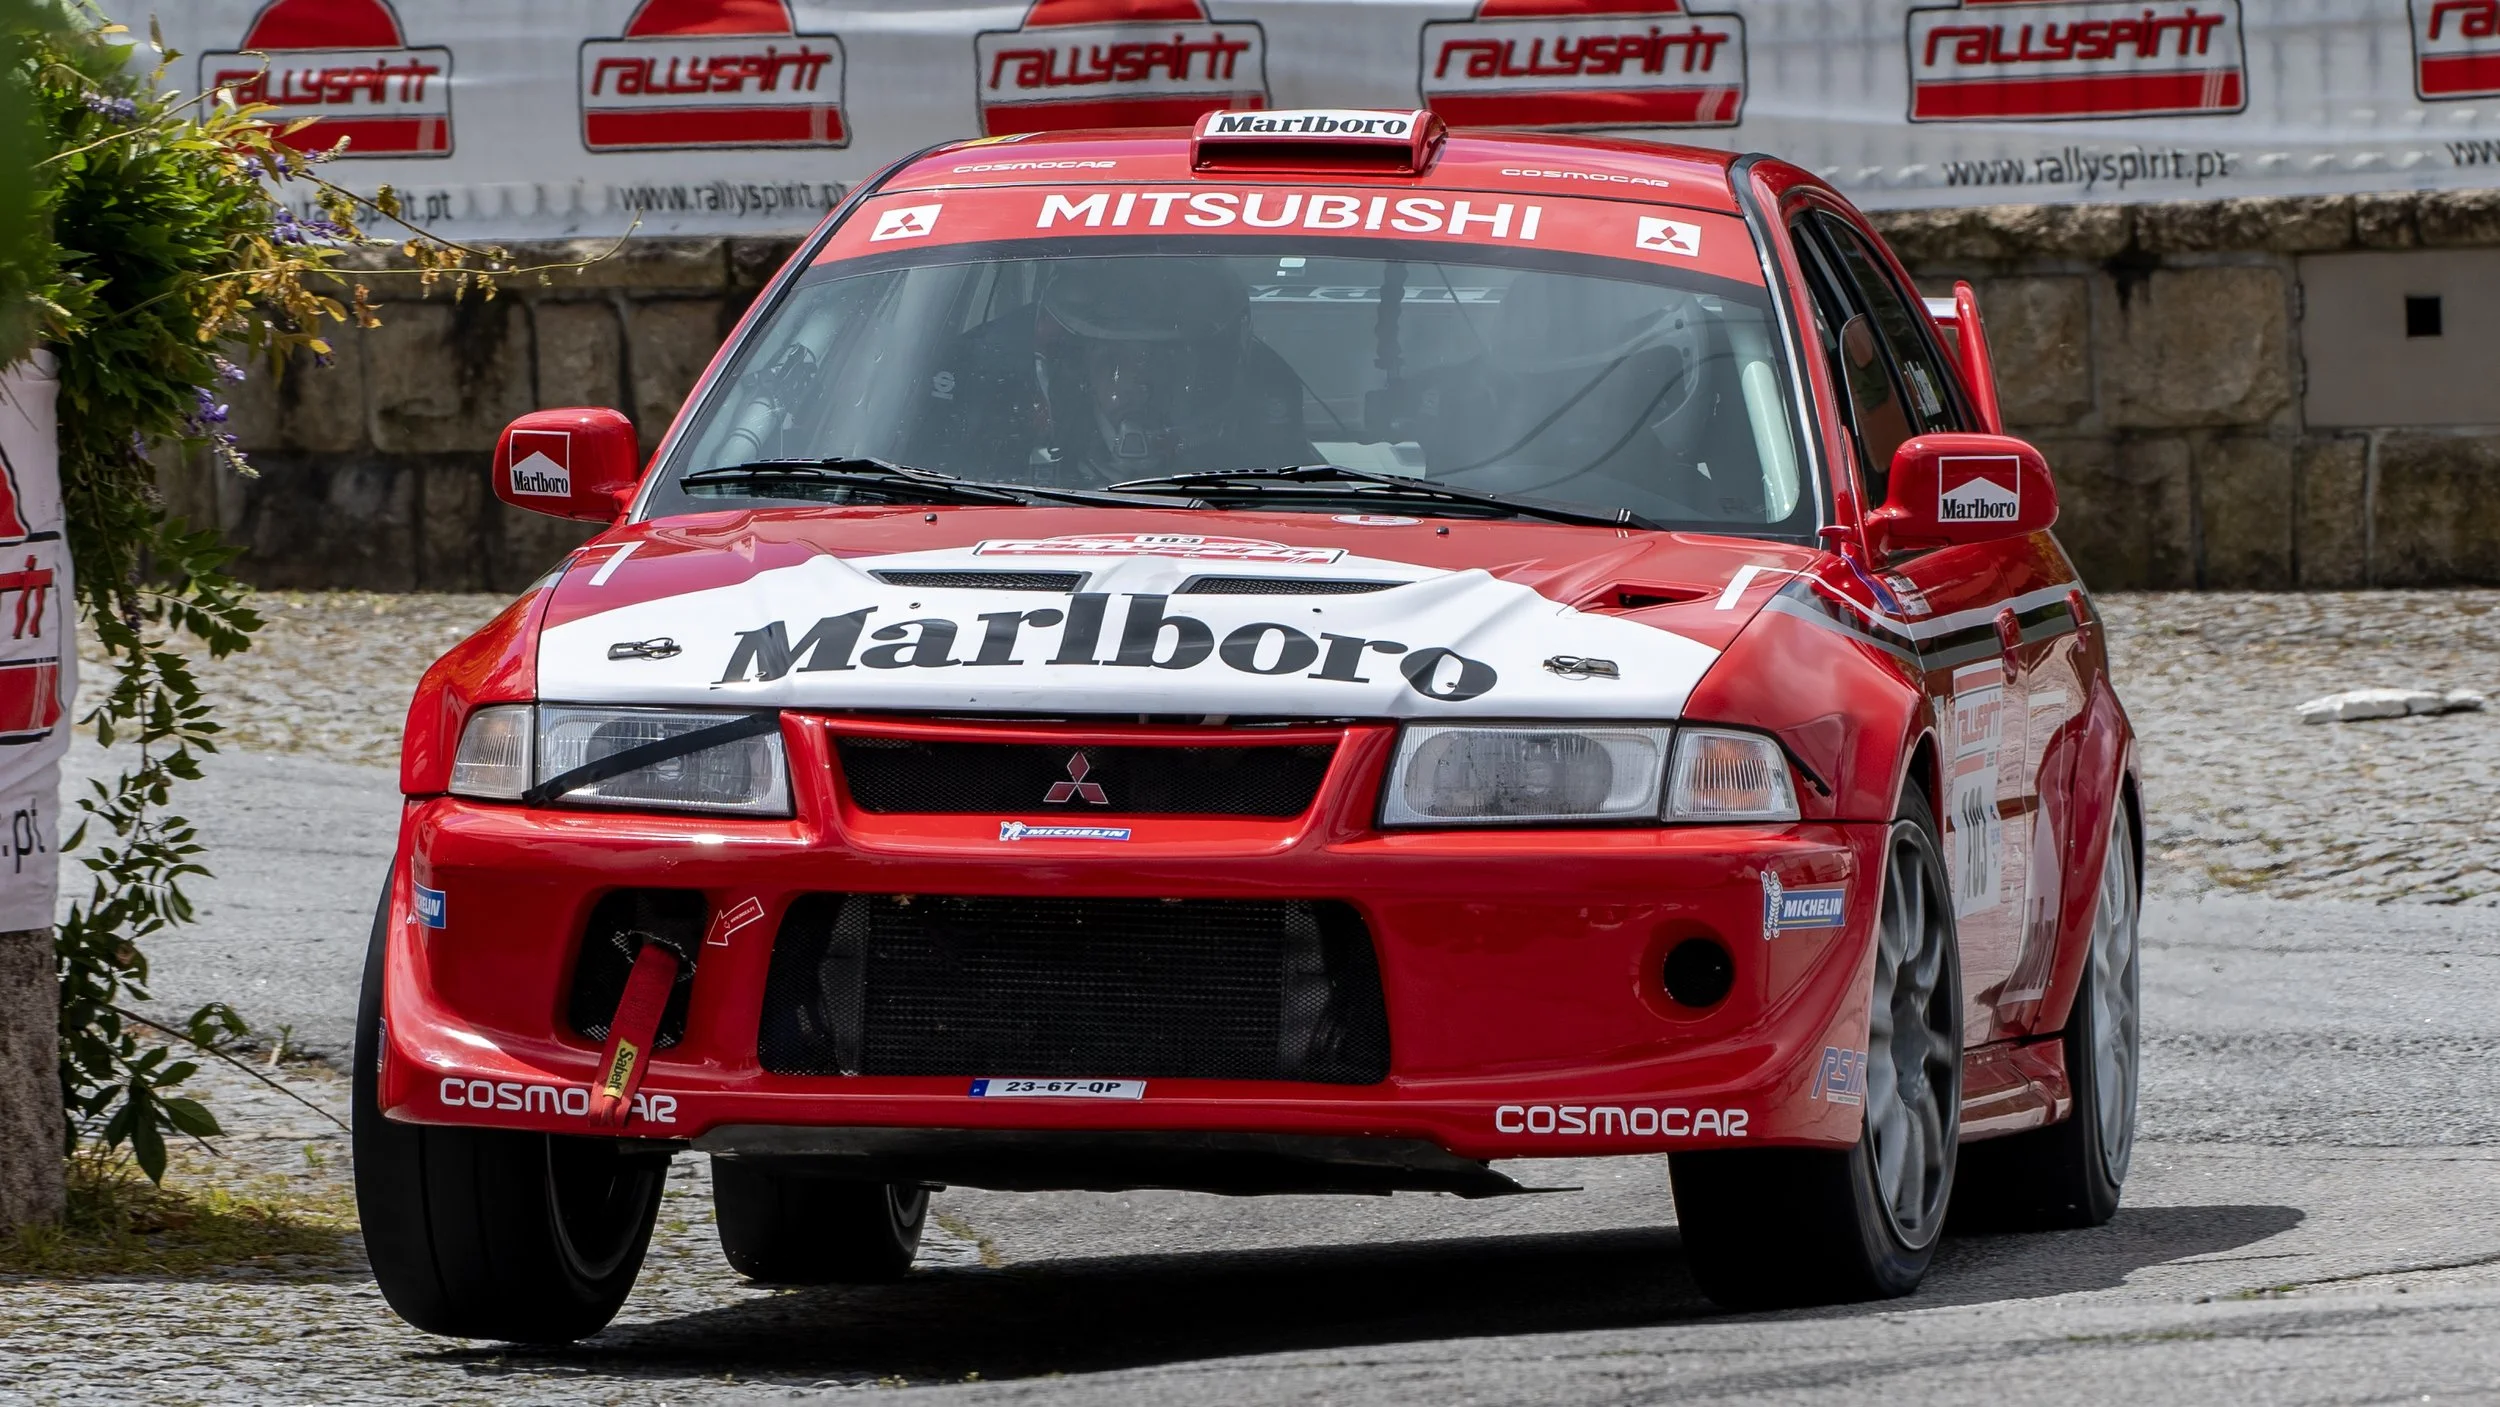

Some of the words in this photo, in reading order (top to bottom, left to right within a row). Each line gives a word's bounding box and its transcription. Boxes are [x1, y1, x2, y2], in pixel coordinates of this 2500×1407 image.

[1215, 112, 1408, 137] Marlboro
[952, 160, 1117, 174] COSMOCAR
[1501, 168, 1670, 188] COSMOCAR
[1942, 144, 2229, 190] www.rallyspirit.pt
[1036, 192, 1543, 240] MITSUBISHI
[512, 469, 569, 494] Marlboro
[1941, 498, 2016, 519] Marlboro
[1145, 536, 1199, 544] 103
[711, 592, 1499, 703] Marlboro
[1026, 828, 1125, 838] MICHELIN
[1784, 898, 1842, 918] MICHELIN
[608, 1047, 635, 1091] Sabelt
[440, 1077, 677, 1123] COSMOAR
[1005, 1081, 1122, 1094] 23-67-QP
[1495, 1105, 1749, 1137] COSMOCAR
